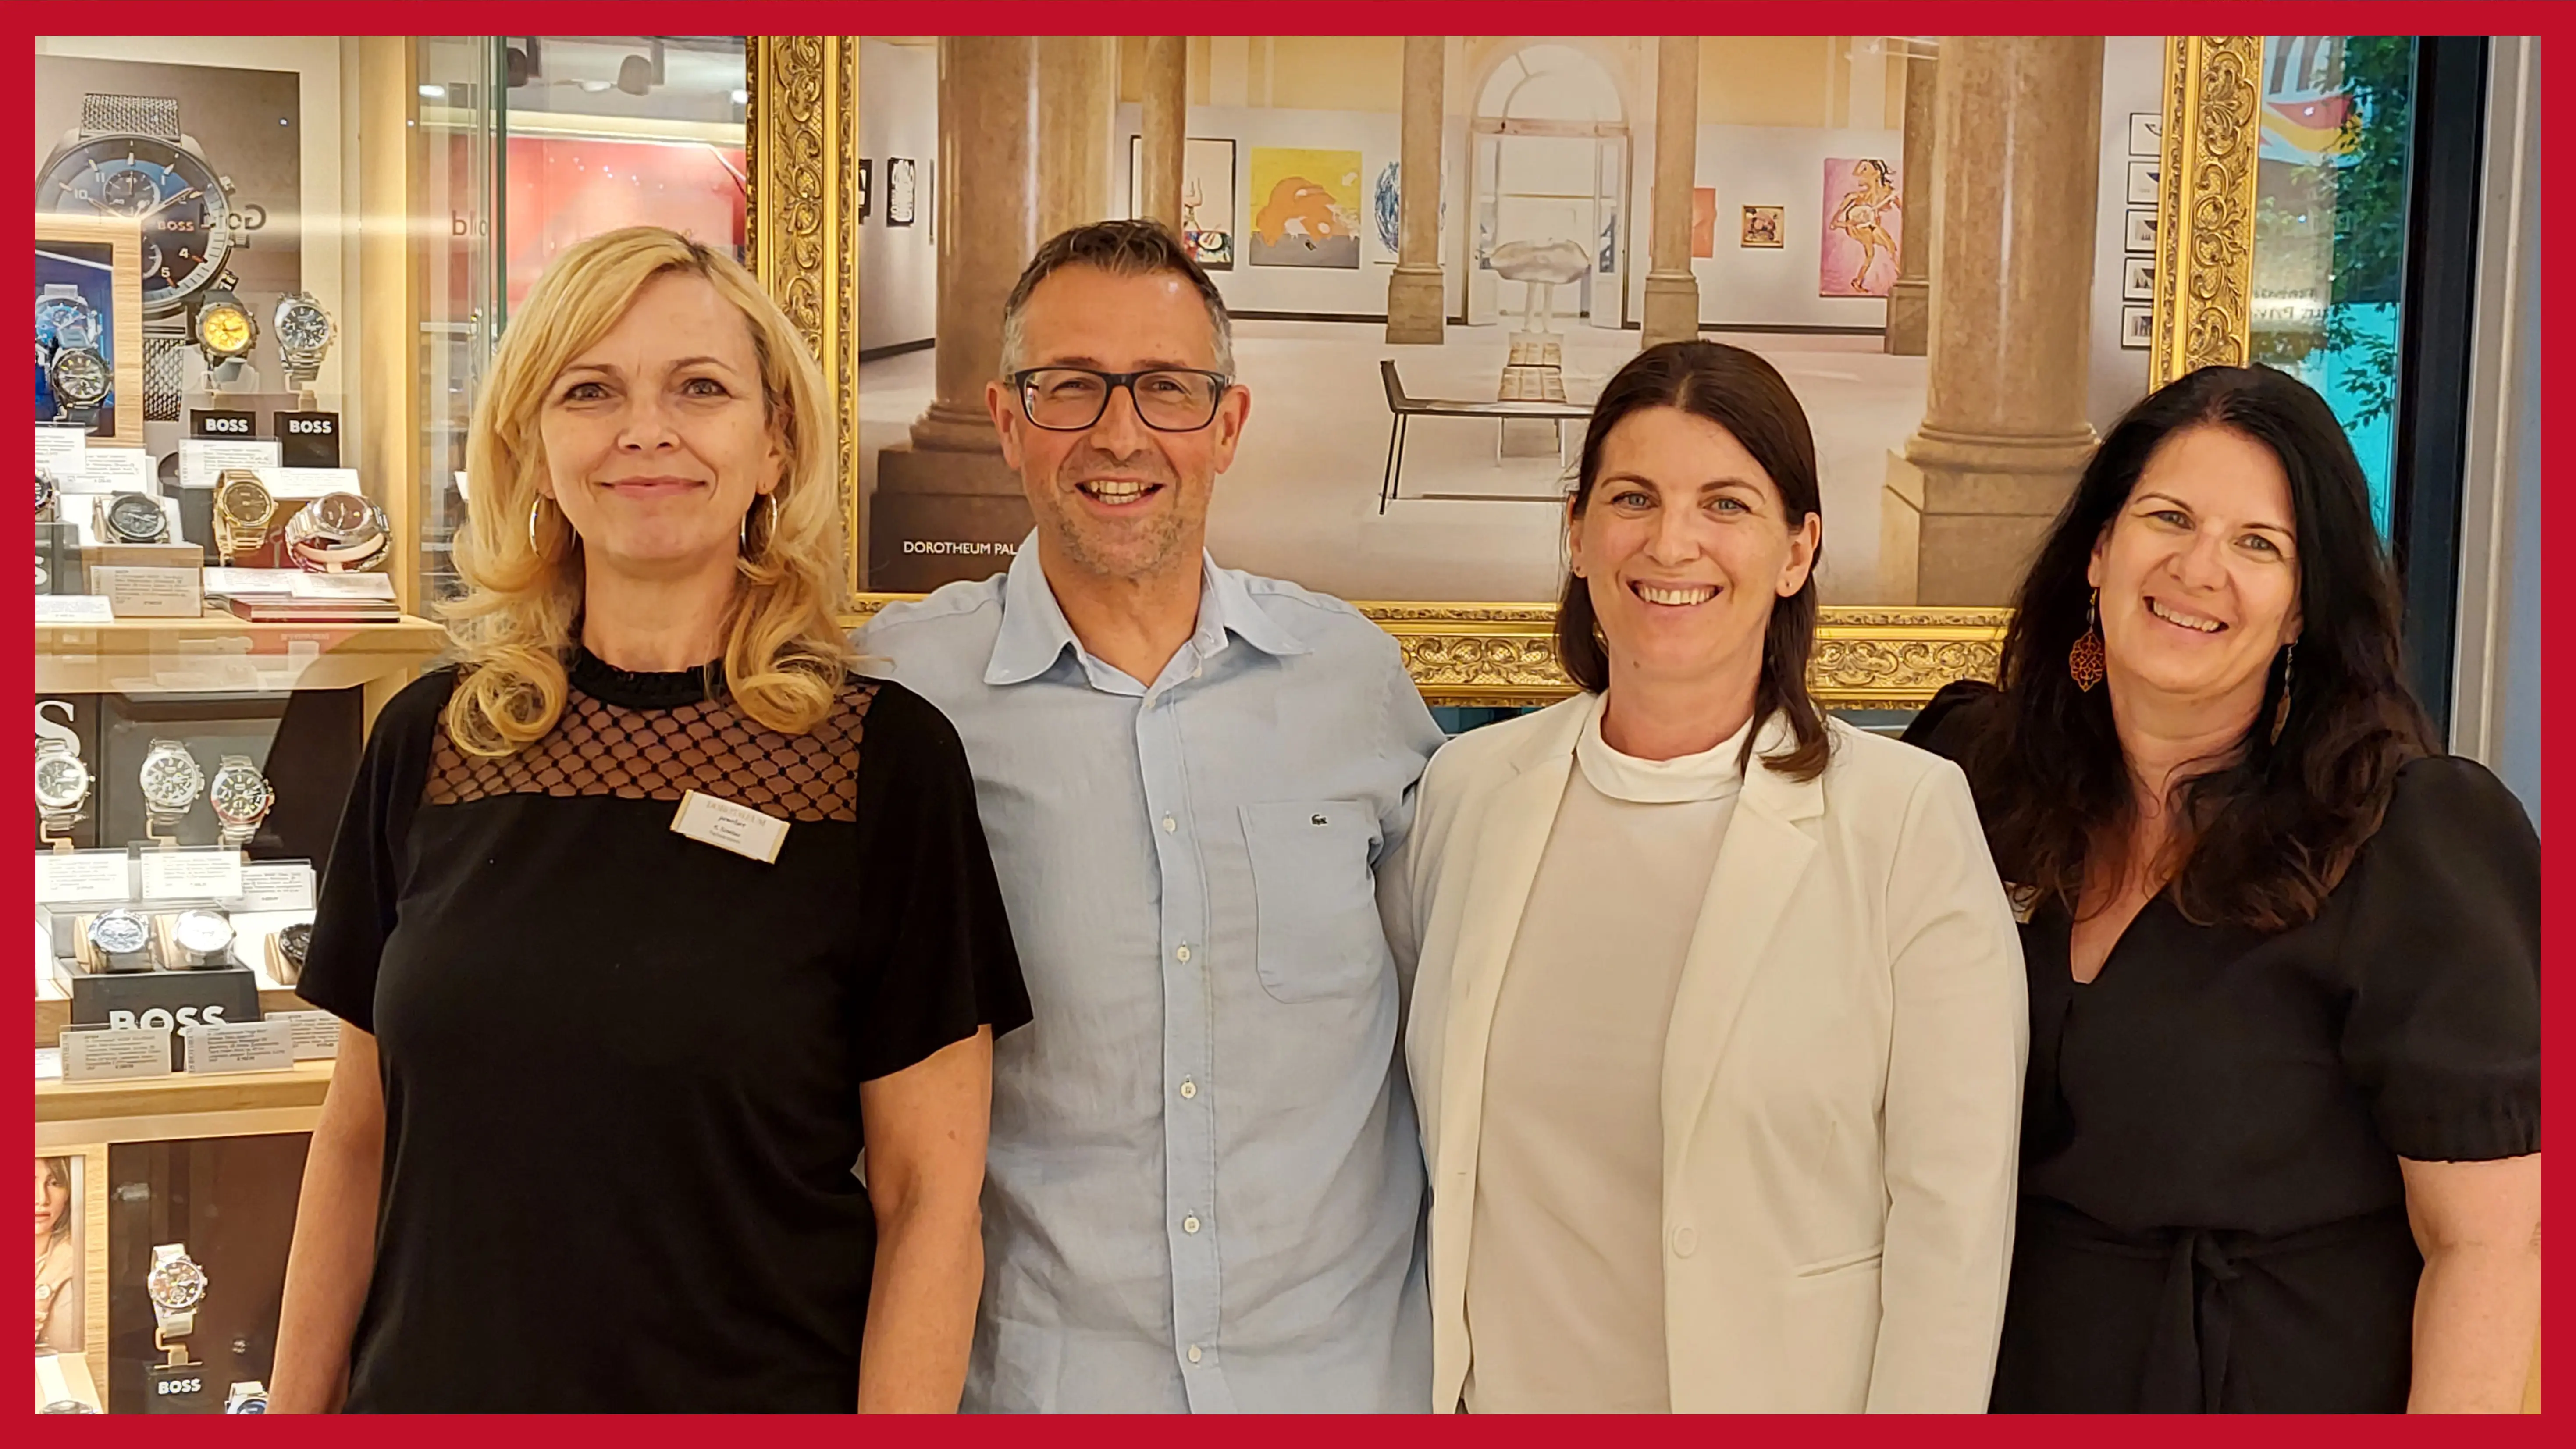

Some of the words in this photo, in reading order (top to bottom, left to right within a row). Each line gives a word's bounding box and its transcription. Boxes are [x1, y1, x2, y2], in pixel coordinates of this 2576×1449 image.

[75, 188, 88, 199] 10
[158, 221, 194, 232] BOSS
[179, 247, 189, 259] 4
[161, 266, 171, 278] 5
[205, 418, 248, 433] BOSS
[289, 420, 332, 434] BOSS
[904, 541, 991, 555] DOROTHEUM
[994, 543, 1019, 556] PAL
[110, 1006, 229, 1037] BOSS
[158, 1378, 202, 1395] BOSS
